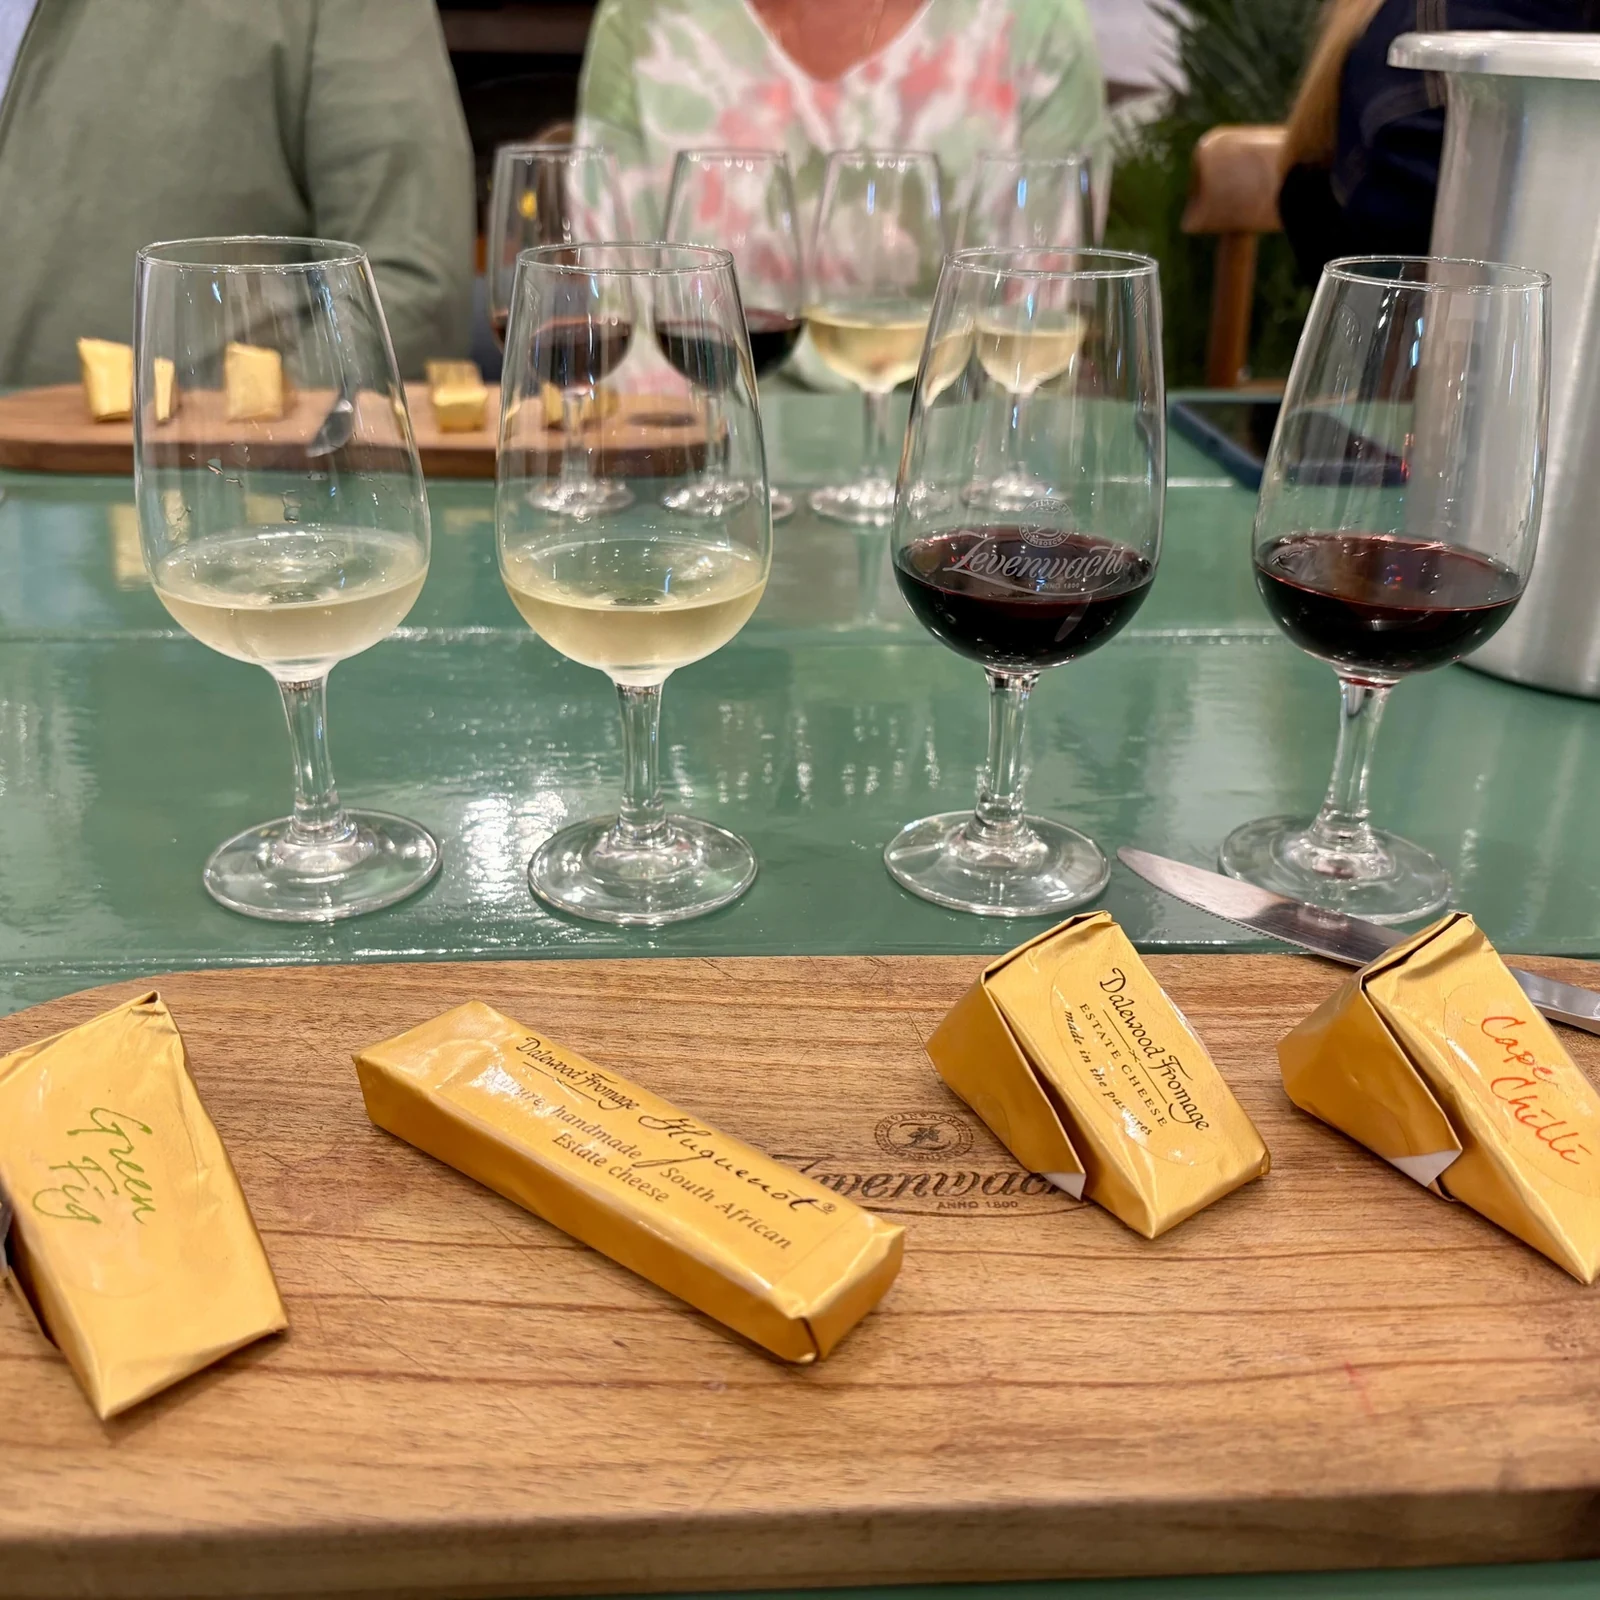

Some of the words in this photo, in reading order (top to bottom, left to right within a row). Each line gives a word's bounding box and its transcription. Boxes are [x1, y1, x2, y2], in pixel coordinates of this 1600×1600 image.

[943, 530, 1130, 596] Zevenwacht
[516, 1036, 588, 1080] Dalewood
[578, 1072, 640, 1110] Fromage
[1064, 1010, 1085, 1046] made
[1080, 1049, 1092, 1064] in
[1090, 1067, 1107, 1088] the
[1079, 1003, 1121, 1060] ESTATE
[1121, 1064, 1168, 1127] CHEESE
[1100, 968, 1166, 1059] Dalewood
[1148, 1055, 1209, 1130] Fromage
[1481, 1016, 1557, 1086] Cape
[32, 1156, 119, 1224] Fig
[66, 1107, 156, 1226] Green
[551, 1105, 642, 1160] handmade
[660, 1167, 715, 1202] South
[714, 1202, 792, 1249] African
[552, 1132, 607, 1168] Estate
[608, 1164, 670, 1203] cheese
[767, 1152, 1060, 1216] venwac
[936, 1201, 979, 1210] ANNO
[985, 1201, 1018, 1209] 1800
